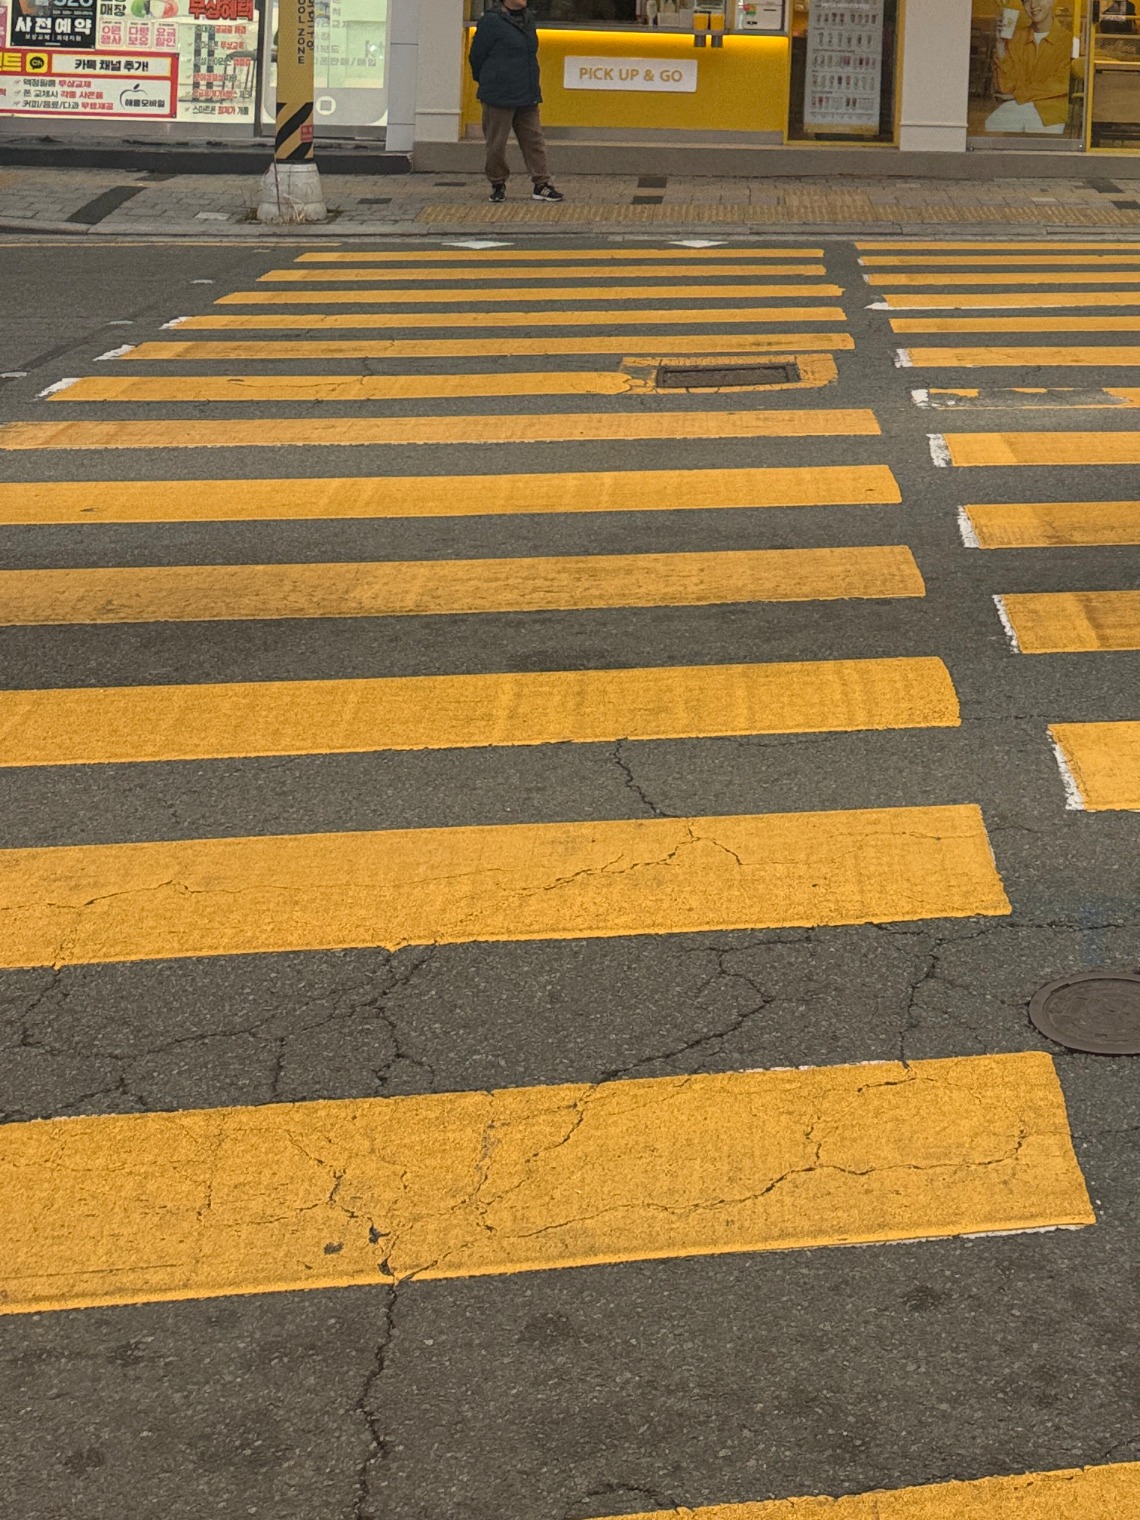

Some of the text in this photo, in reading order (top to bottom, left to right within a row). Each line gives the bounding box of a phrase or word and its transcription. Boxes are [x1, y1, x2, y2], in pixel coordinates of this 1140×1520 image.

[100, 3, 127, 17] 매장
[15, 16, 92, 35] 사전예약
[297, 28, 306, 65] ZONE
[74, 58, 97, 71] 카톡
[99, 59, 122, 72] 채널
[578, 67, 683, 82] PICK UP & GO
